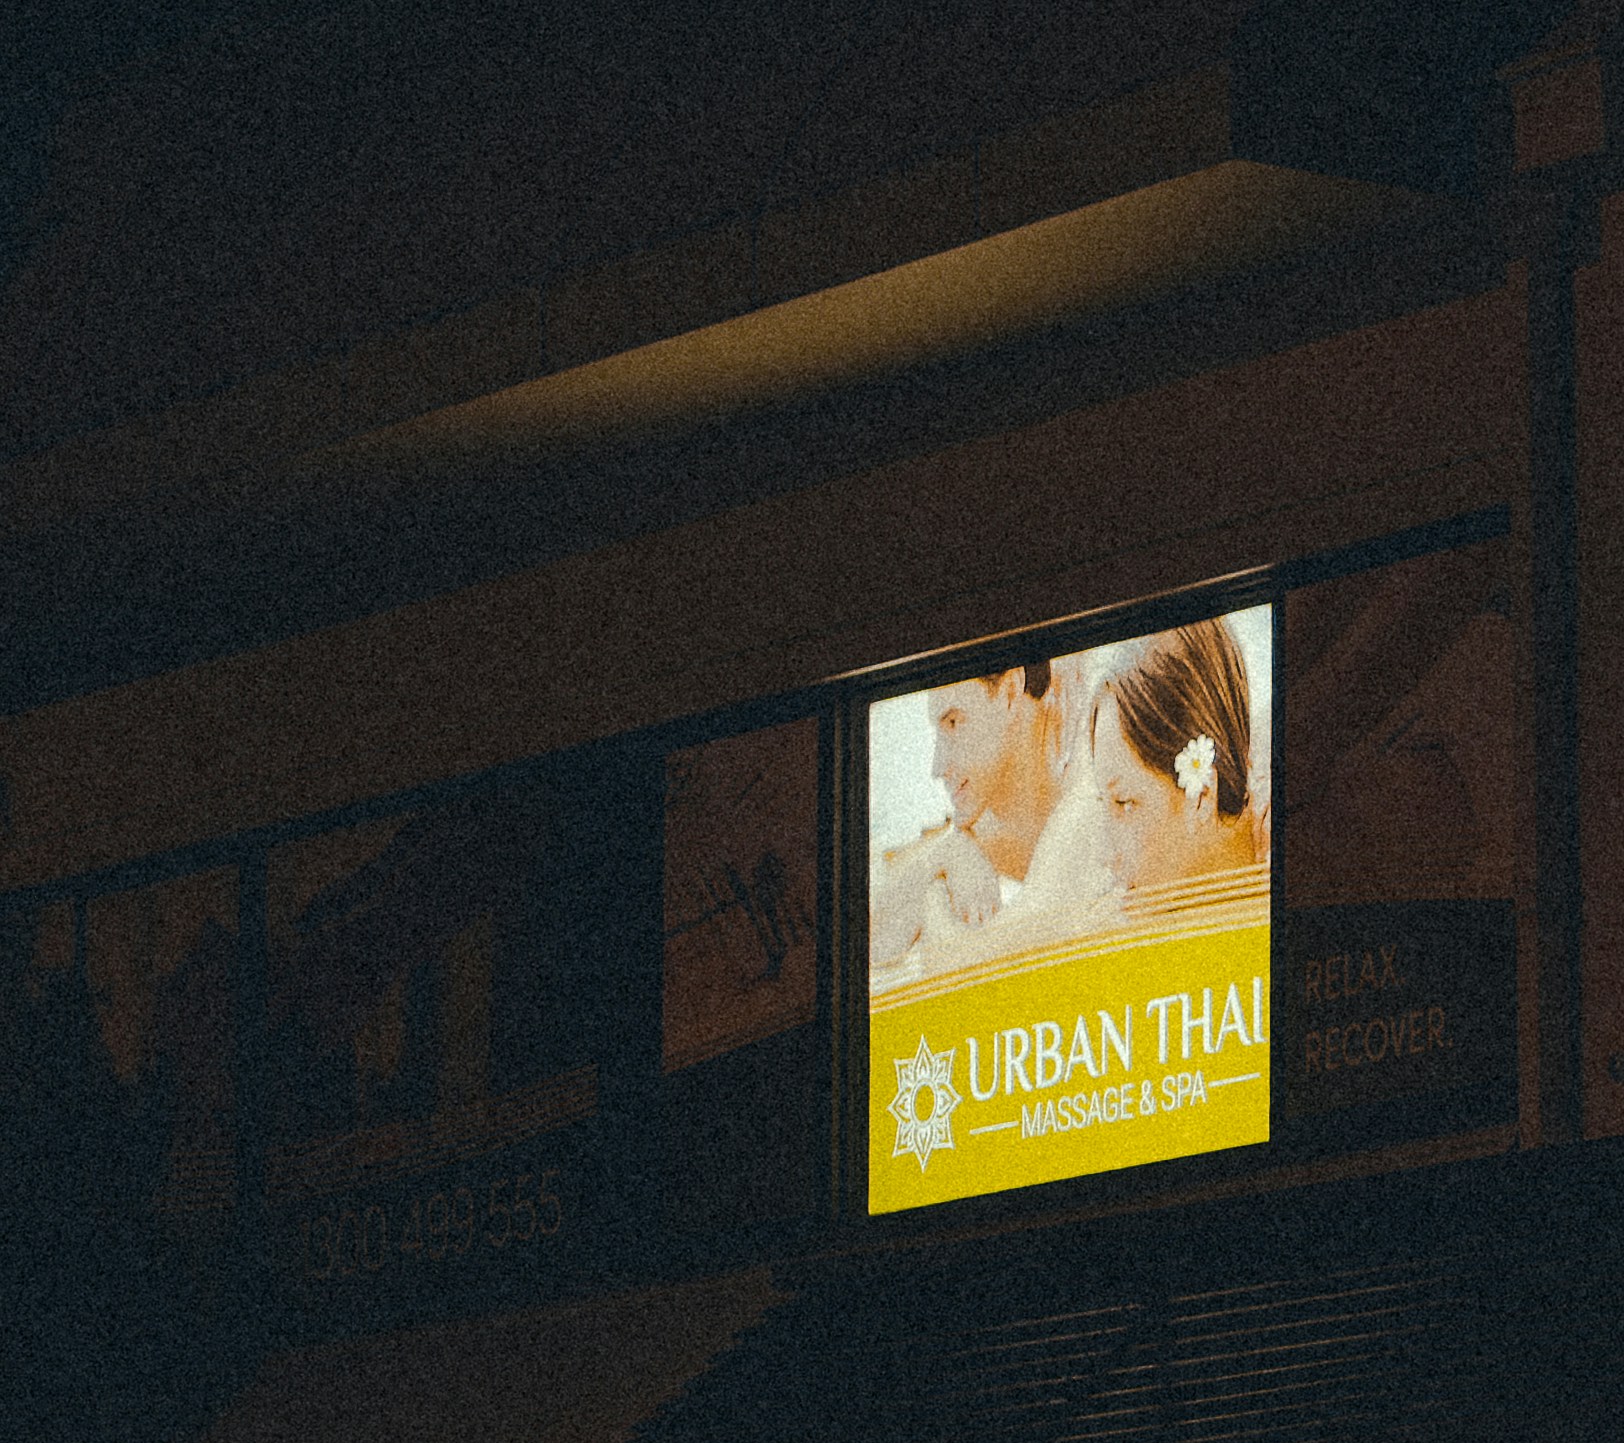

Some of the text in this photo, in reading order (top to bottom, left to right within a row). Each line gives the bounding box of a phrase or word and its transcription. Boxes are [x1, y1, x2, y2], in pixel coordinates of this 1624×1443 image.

[1304, 945, 1405, 1003] RELAX.
[966, 976, 1268, 1102] URBAN THAI
[1304, 1006, 1454, 1073] RECOVER.
[1020, 1070, 1208, 1139] MASSAGE & SPA
[400, 1187, 475, 1261] 499
[487, 1169, 563, 1248] 555
